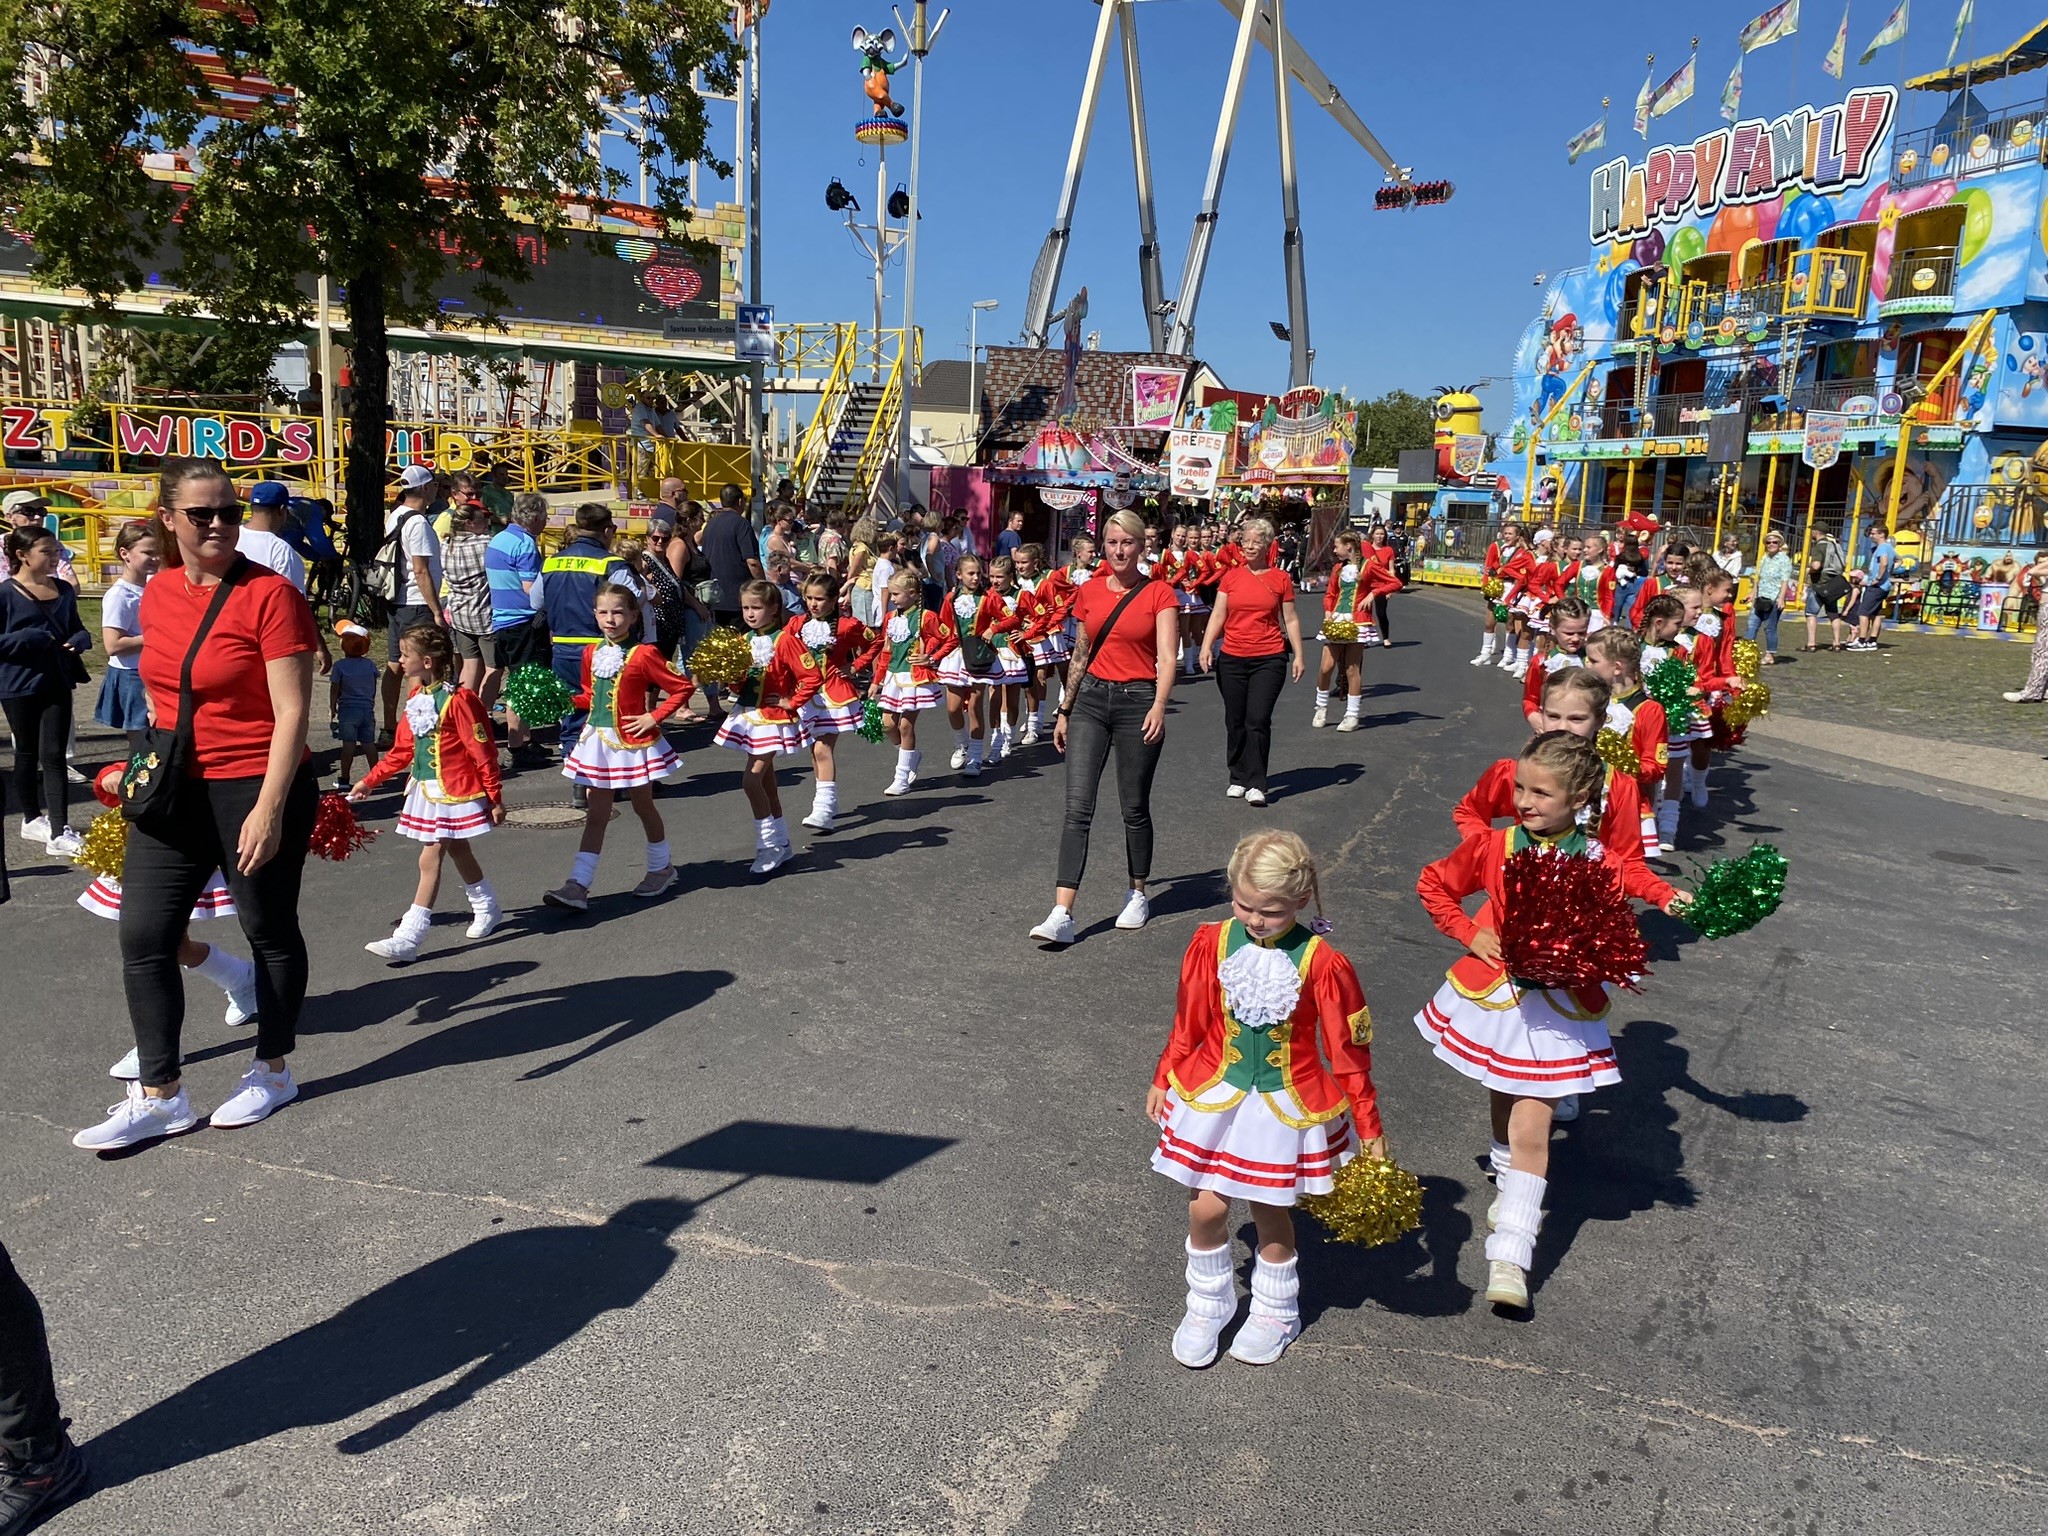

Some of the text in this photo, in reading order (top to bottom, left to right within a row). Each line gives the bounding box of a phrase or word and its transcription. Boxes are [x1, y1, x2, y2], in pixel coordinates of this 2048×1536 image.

[1592, 92, 1893, 239] HAPPY FAMILY
[670, 325, 696, 334] Sparkasse
[1137, 392, 1175, 425] Cocktails
[1, 407, 75, 451] ZT
[118, 412, 313, 463] WIRD'S
[1172, 431, 1222, 450] CRÊPES
[1643, 439, 1681, 456] Fun
[1177, 467, 1210, 478] nutella
[1044, 491, 1078, 501] CRPES
[556, 558, 588, 569] THW
